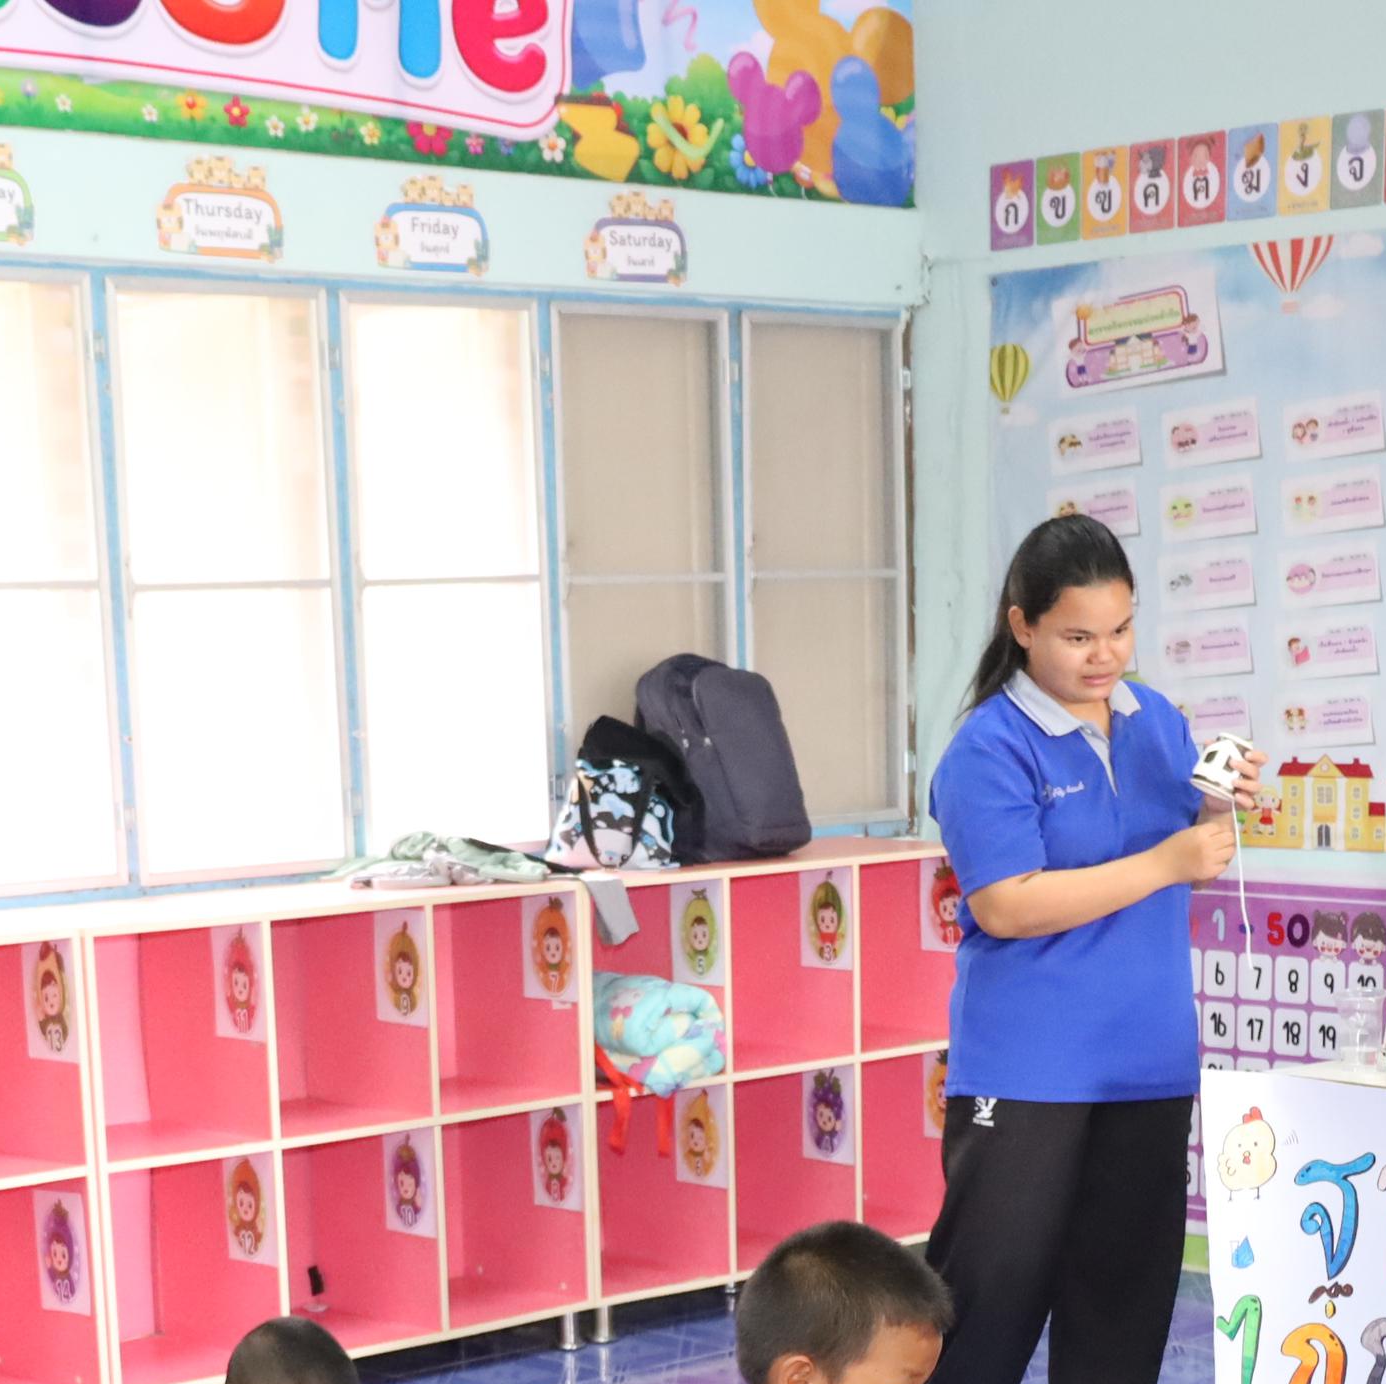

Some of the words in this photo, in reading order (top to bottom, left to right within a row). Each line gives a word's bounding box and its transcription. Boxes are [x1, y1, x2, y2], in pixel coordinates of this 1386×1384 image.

[1296, 162, 1309, 188] ง
[1348, 155, 1363, 182] จ
[1143, 183, 1160, 208] ค
[183, 198, 262, 225] Thursday
[1004, 202, 1019, 226] ก
[410, 217, 460, 240] Friday
[609, 230, 673, 252] Saturday
[1267, 911, 1311, 948] 50
[823, 945, 833, 961] 3
[696, 957, 706, 976] 5
[1215, 961, 1225, 986] 6
[1253, 966, 1262, 989] 7
[1288, 969, 1299, 994] 8
[1324, 973, 1334, 994] 9
[548, 972, 560, 994] 7
[236, 1009, 250, 1030] 11
[1210, 1011, 1227, 1038] 16
[1246, 1018, 1264, 1042] 17
[1283, 1021, 1301, 1046] 18
[1318, 1024, 1336, 1050] 19
[47, 1023, 64, 1053] 13
[239, 1232, 257, 1255] 12
[55, 1280, 72, 1302] 14
